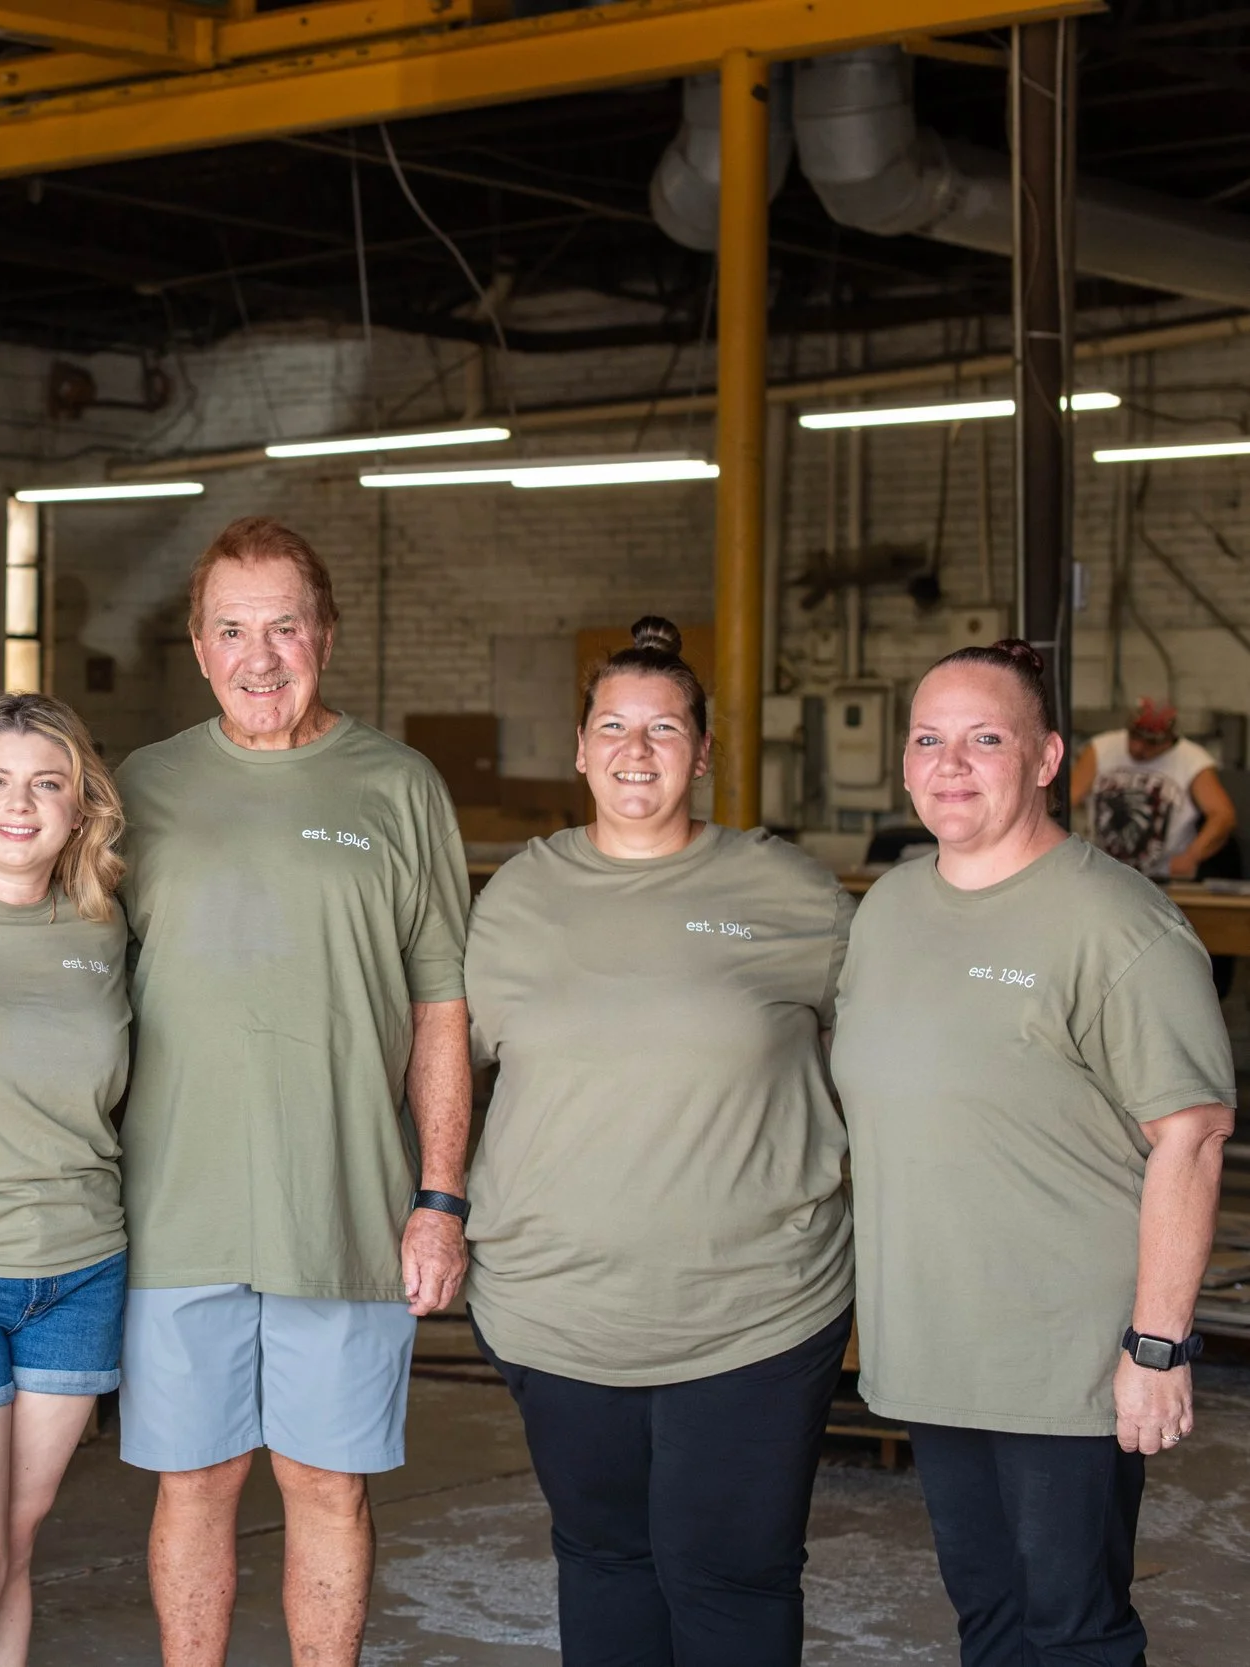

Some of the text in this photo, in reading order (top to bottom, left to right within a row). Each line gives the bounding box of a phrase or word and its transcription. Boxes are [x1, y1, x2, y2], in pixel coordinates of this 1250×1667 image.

[301, 828, 371, 851] est. 1946
[686, 920, 752, 940] est. 1946
[62, 957, 88, 970] est.
[968, 965, 1036, 989] est. 1946
